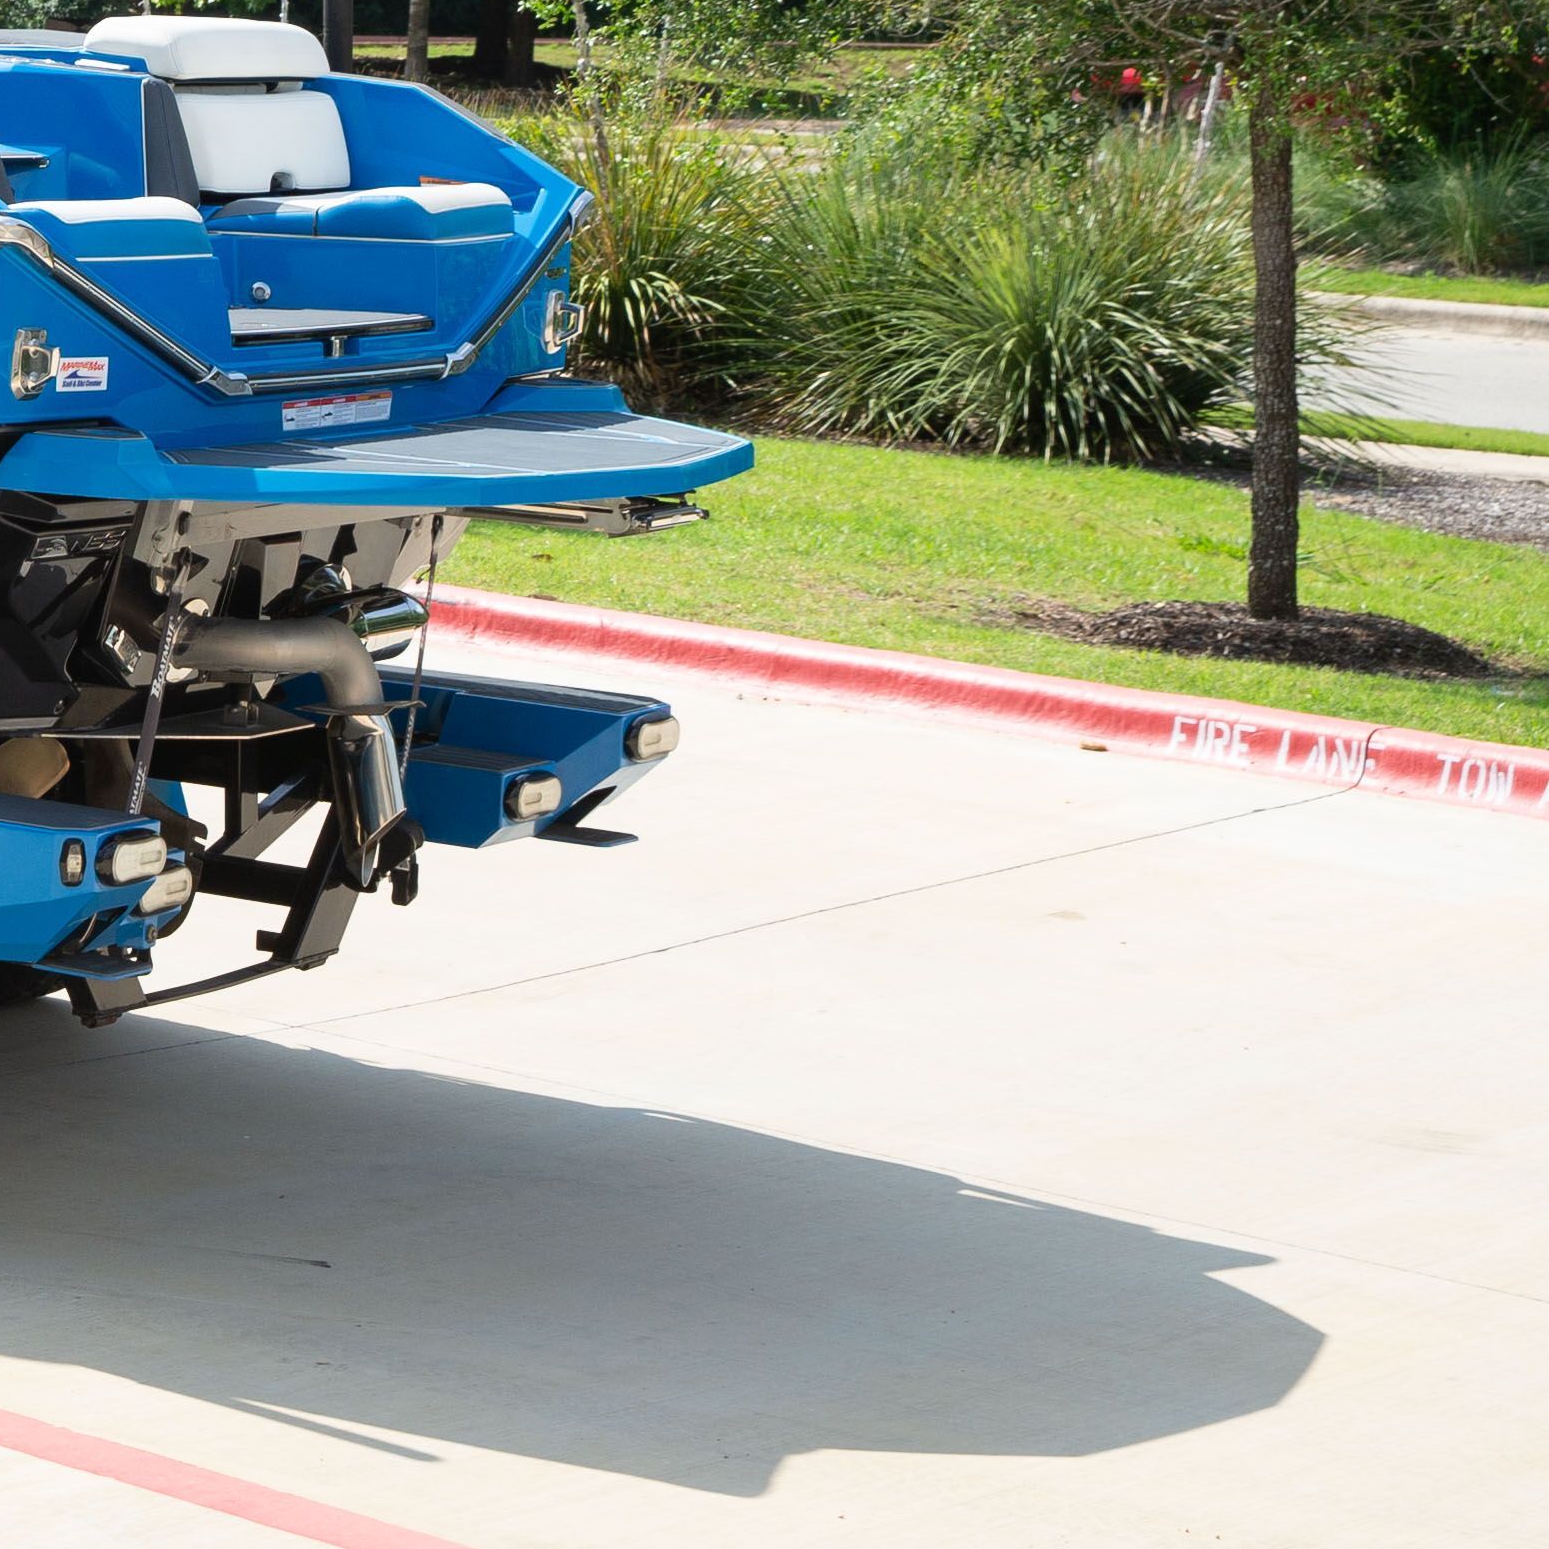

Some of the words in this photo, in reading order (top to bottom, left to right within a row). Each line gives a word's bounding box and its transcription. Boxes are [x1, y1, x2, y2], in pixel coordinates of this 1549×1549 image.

[1168, 716, 1256, 766] FIRE
[1275, 729, 1387, 783] LANE
[1436, 753, 1516, 803] TOW
